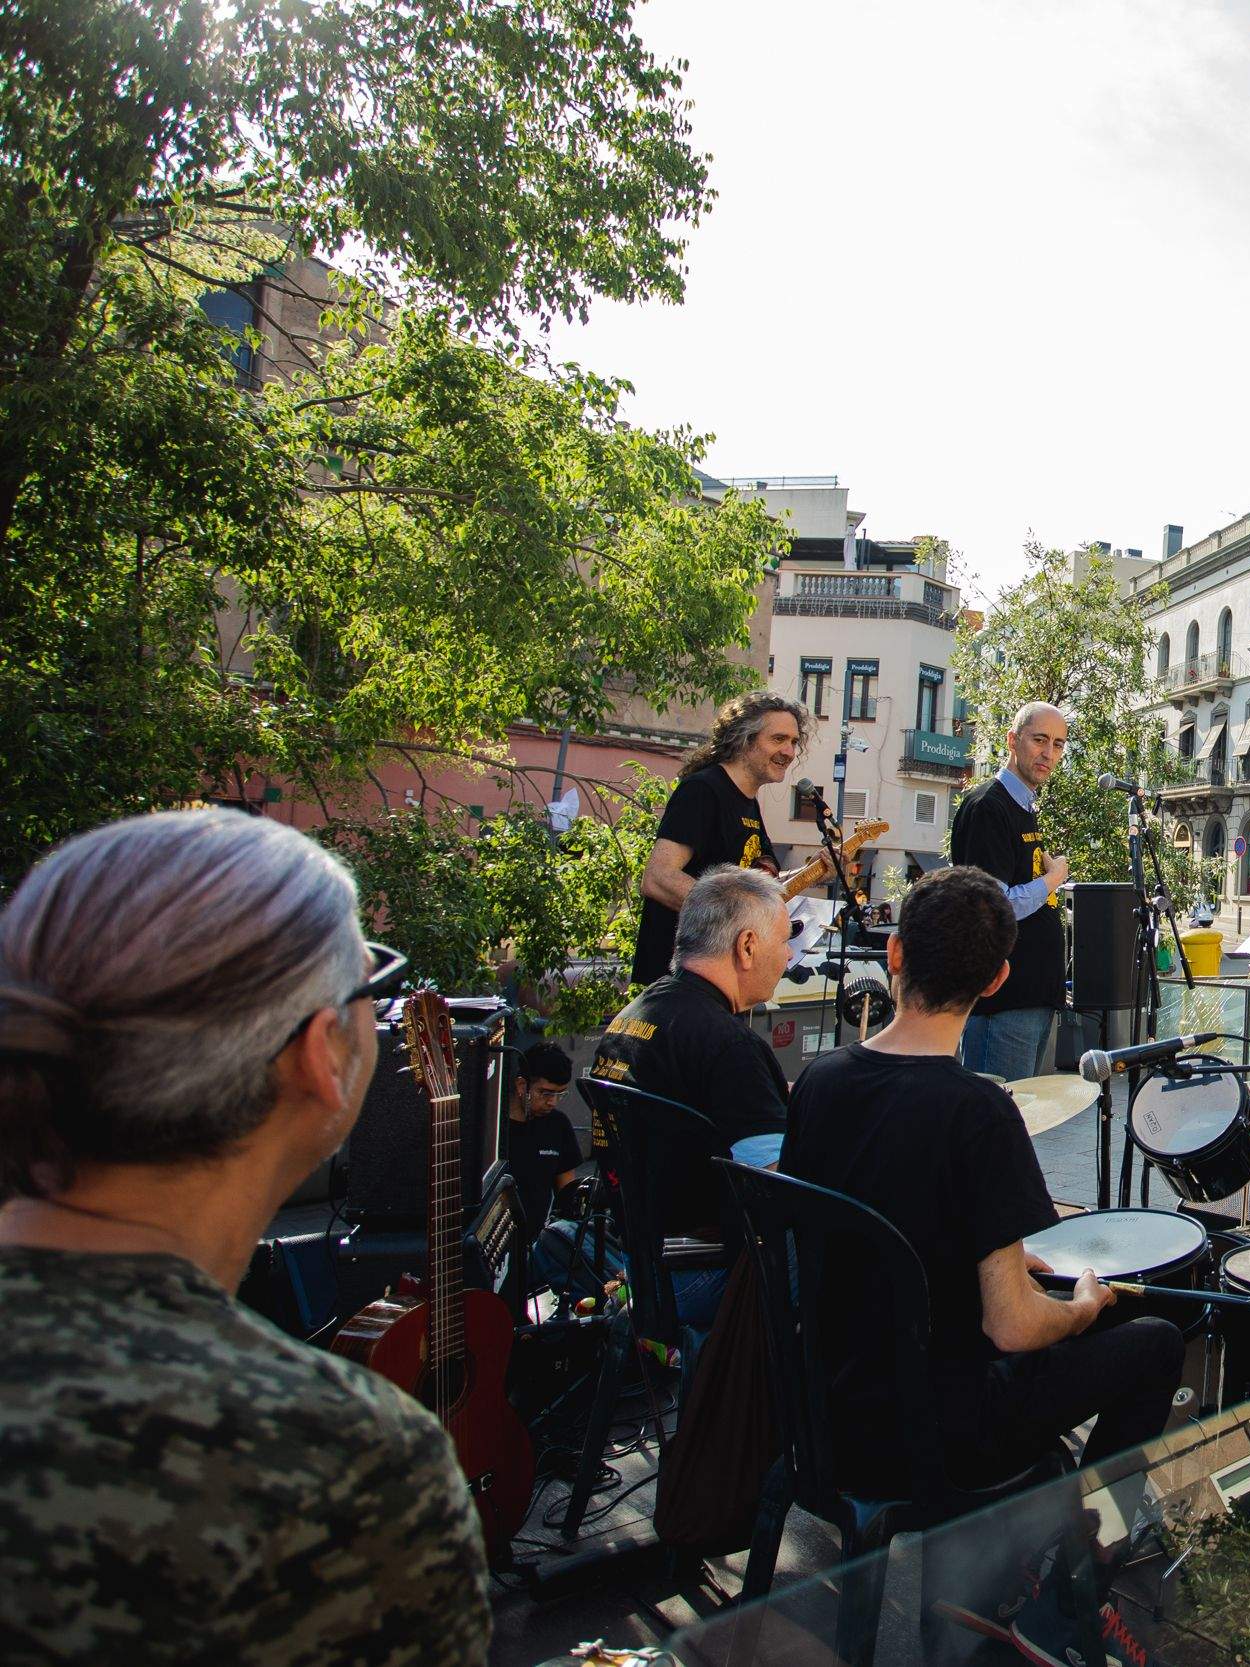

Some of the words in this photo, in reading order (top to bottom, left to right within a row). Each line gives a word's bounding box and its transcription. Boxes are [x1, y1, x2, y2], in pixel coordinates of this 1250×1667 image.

[804, 662, 830, 671] Proddigia
[851, 663, 877, 672] Proddigia
[921, 740, 961, 761] Proddigia
[777, 1023, 790, 1035] NO
